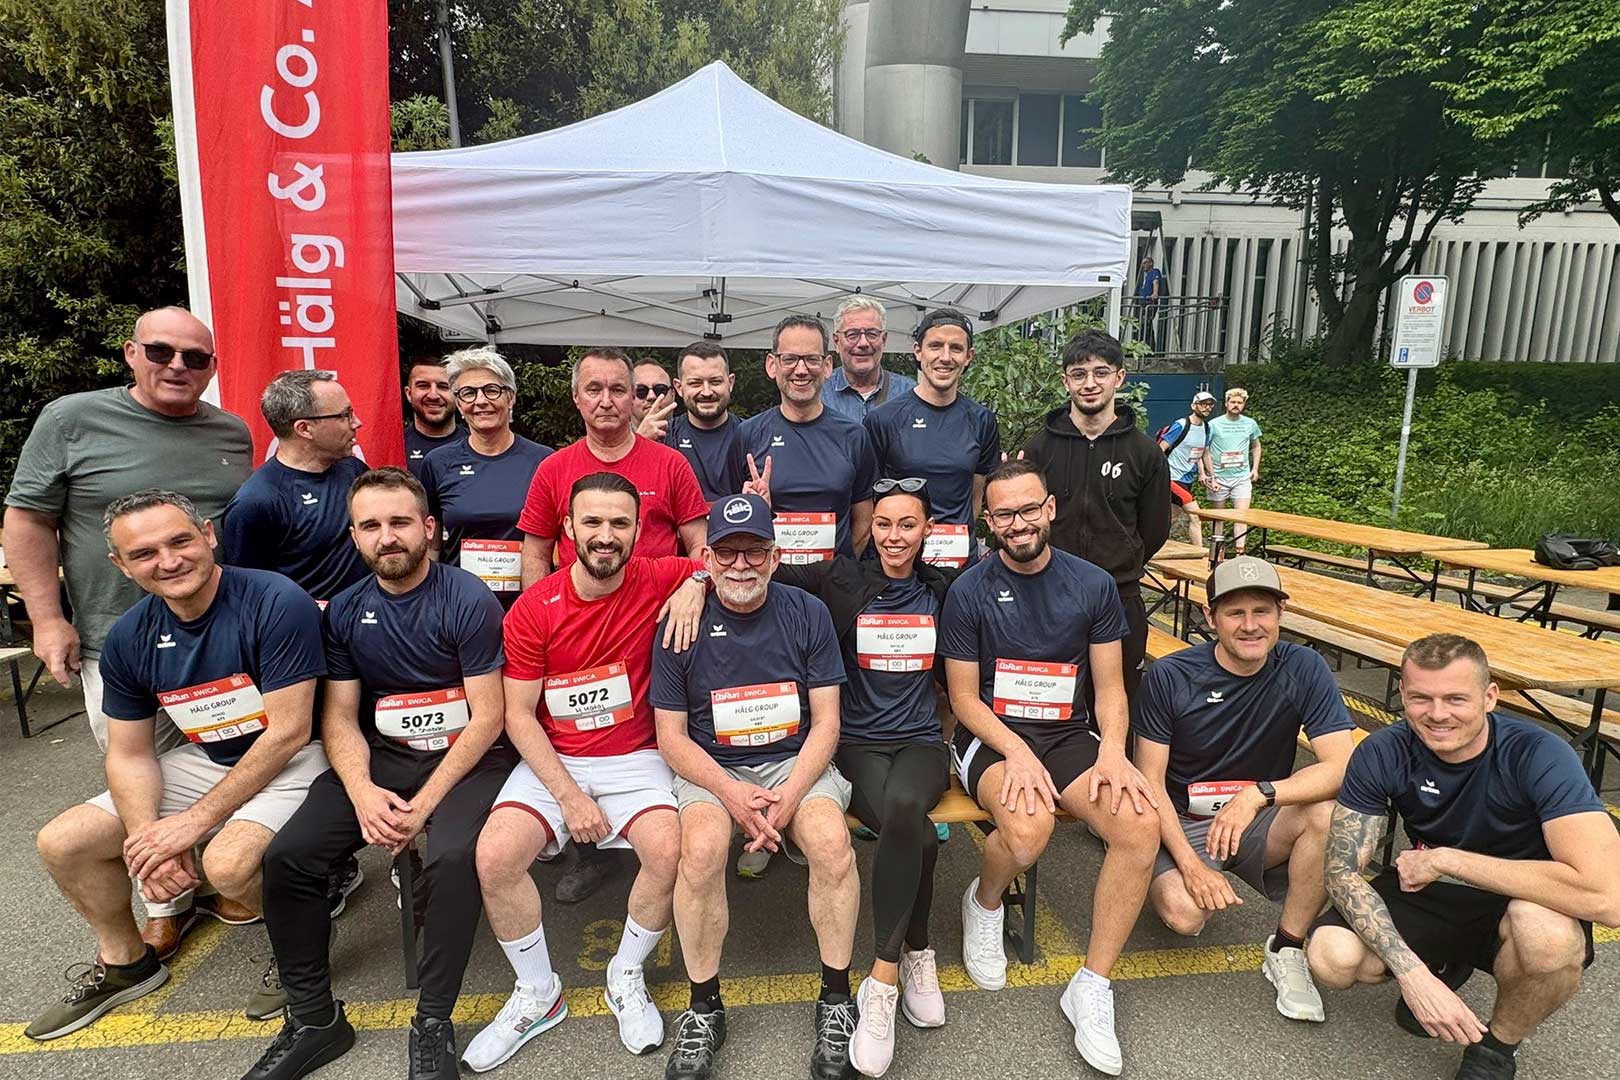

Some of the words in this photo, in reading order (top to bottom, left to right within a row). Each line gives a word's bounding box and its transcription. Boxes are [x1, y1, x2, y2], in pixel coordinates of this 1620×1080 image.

[260, 28, 321, 139] Co.
[267, 161, 326, 212] &
[276, 233, 345, 381] Hälg
[1101, 461, 1124, 479] 06
[1026, 665, 1049, 673] SWICA
[572, 673, 597, 684] SWICA
[1033, 681, 1057, 689] GROUP
[192, 686, 219, 697] SWICA
[568, 687, 610, 708] 5072
[211, 697, 237, 710] GROUP
[407, 696, 433, 705] SWICA
[754, 703, 779, 712] GROUP
[401, 711, 445, 730] 5073
